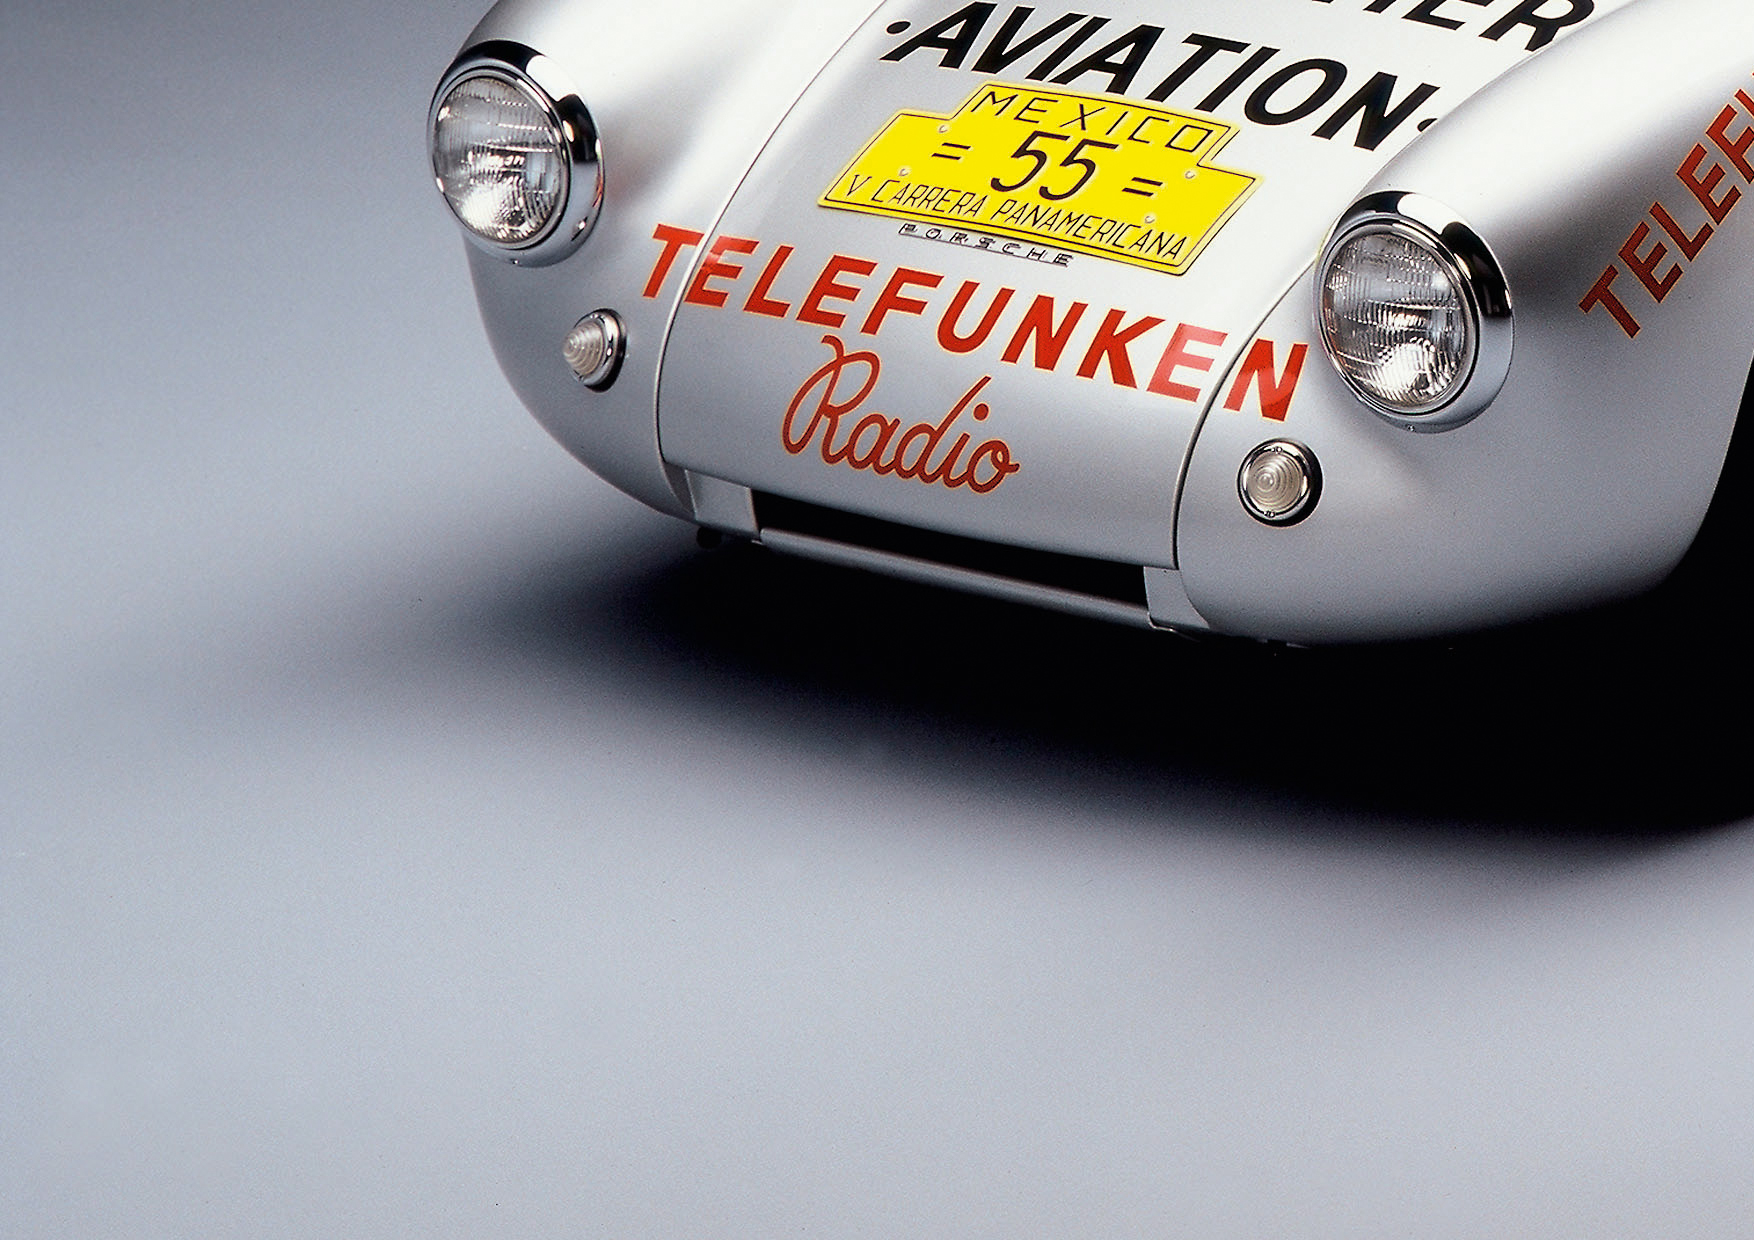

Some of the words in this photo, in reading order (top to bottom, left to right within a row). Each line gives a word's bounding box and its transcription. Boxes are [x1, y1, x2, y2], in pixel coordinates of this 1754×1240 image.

[970, 90, 1214, 154] MEXICO
[990, 130, 1120, 201] 55
[846, 174, 871, 198] V
[870, 179, 990, 218] CARRERA
[990, 198, 1188, 262] PANAMERICANA
[898, 222, 1075, 267] PORSCHE
[641, 223, 1310, 423] TELEFUNKEN
[781, 333, 1021, 495] Radio
